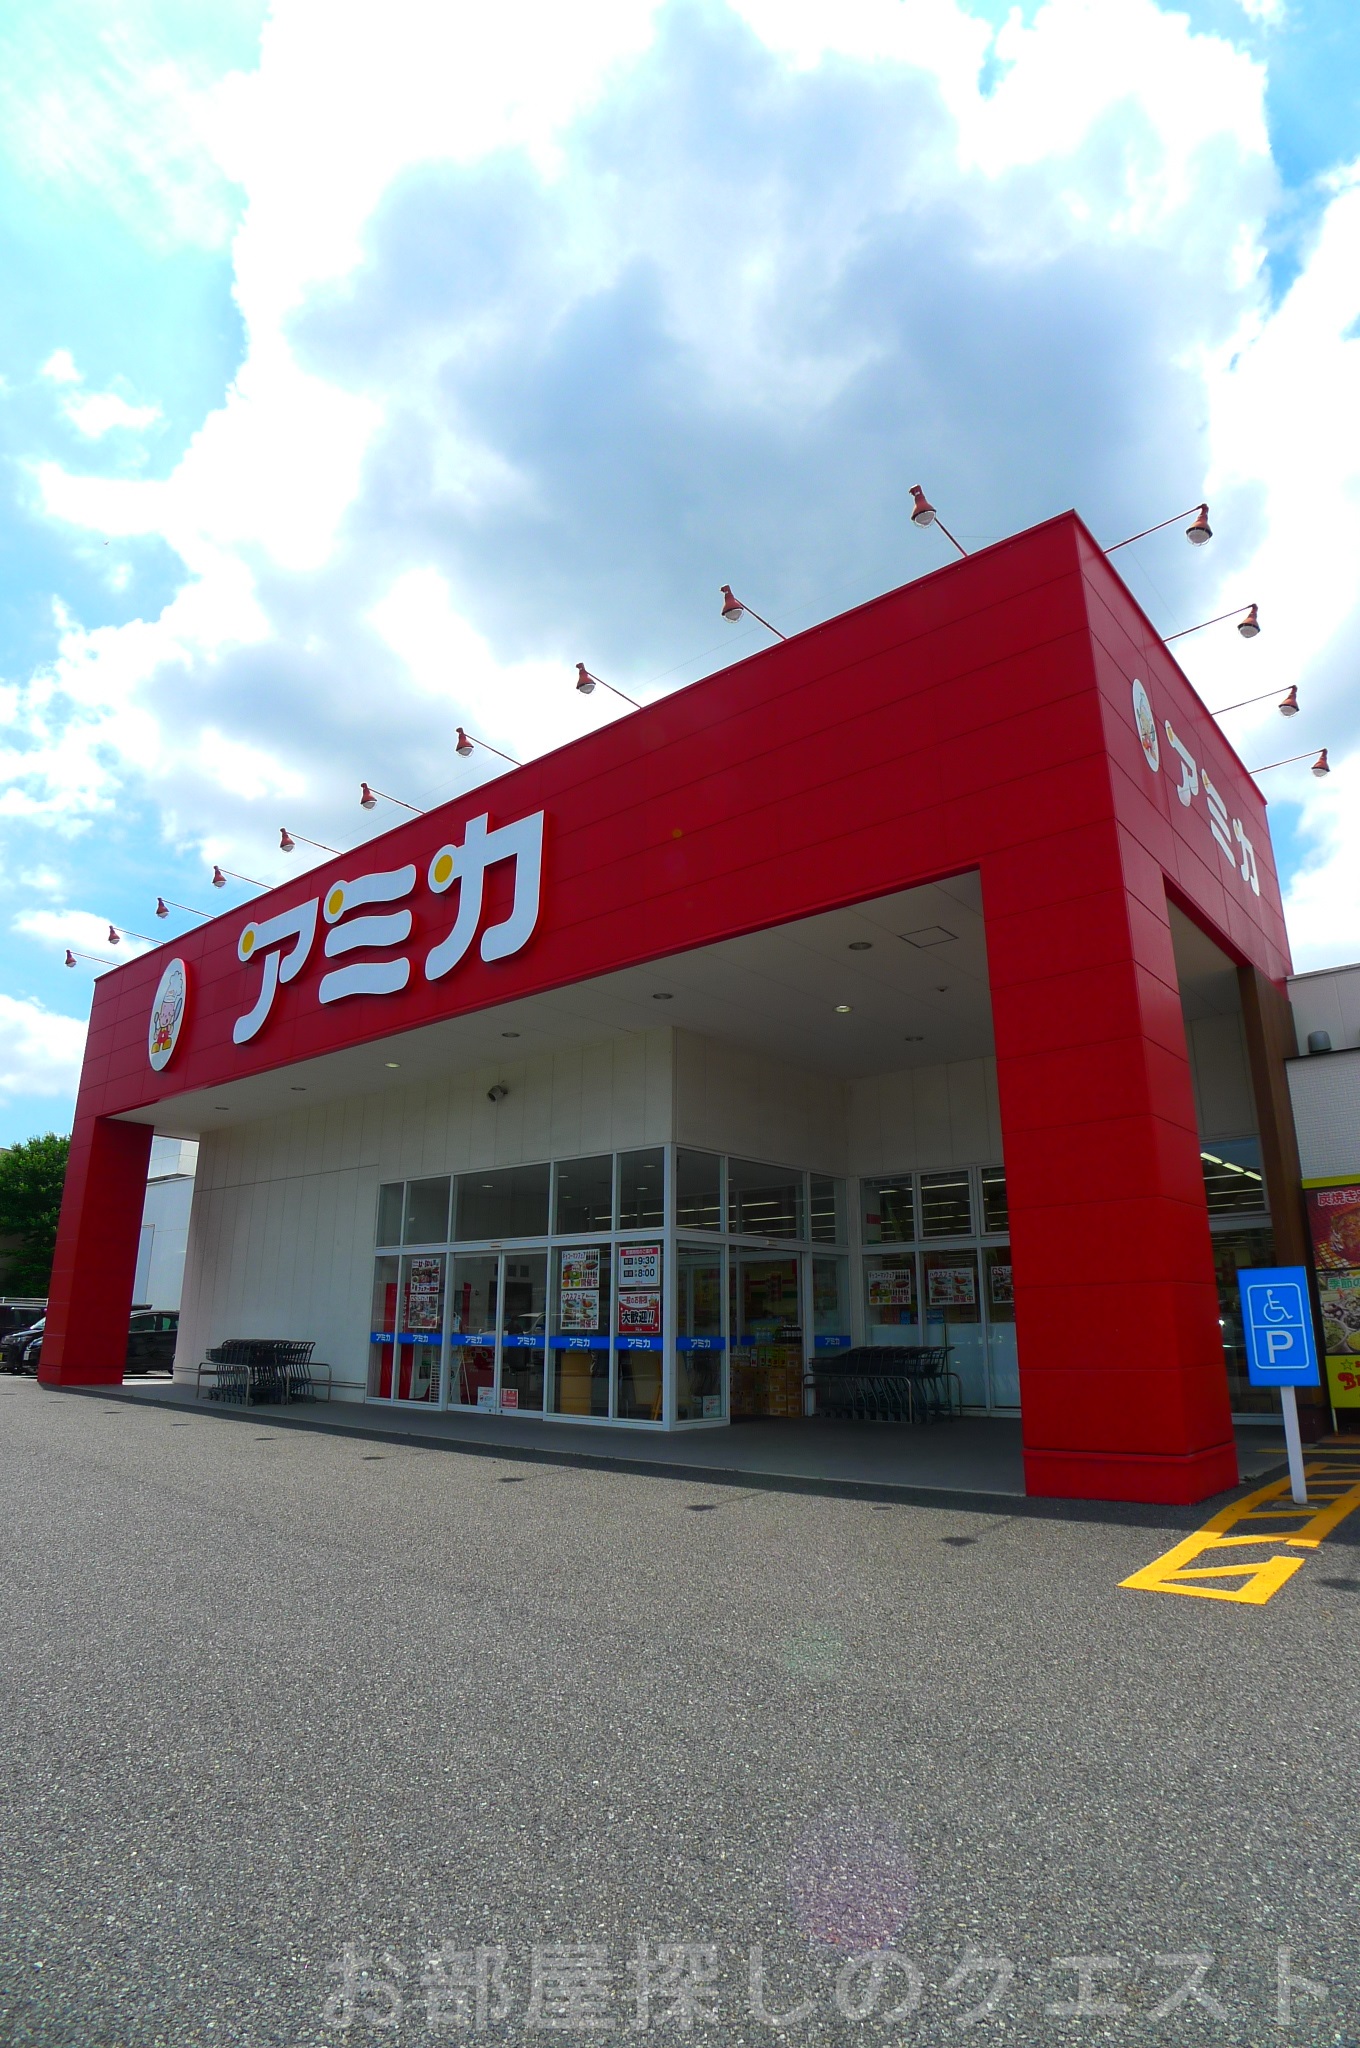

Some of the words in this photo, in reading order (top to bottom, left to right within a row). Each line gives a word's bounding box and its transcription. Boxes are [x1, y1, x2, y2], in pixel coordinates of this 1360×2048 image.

[1163, 719, 1260, 896] アミカ
[232, 809, 545, 1044] アミカ
[375, 1333, 391, 1342] アミカ
[412, 1333, 428, 1343] アミカ
[464, 1335, 483, 1344] アミカ
[516, 1336, 537, 1346] アミカ
[824, 1337, 840, 1346] アミカ
[569, 1338, 590, 1348] アミカ
[627, 1338, 651, 1348] アミカ
[690, 1338, 711, 1349] アミカ
[1266, 1330, 1294, 1364] P
